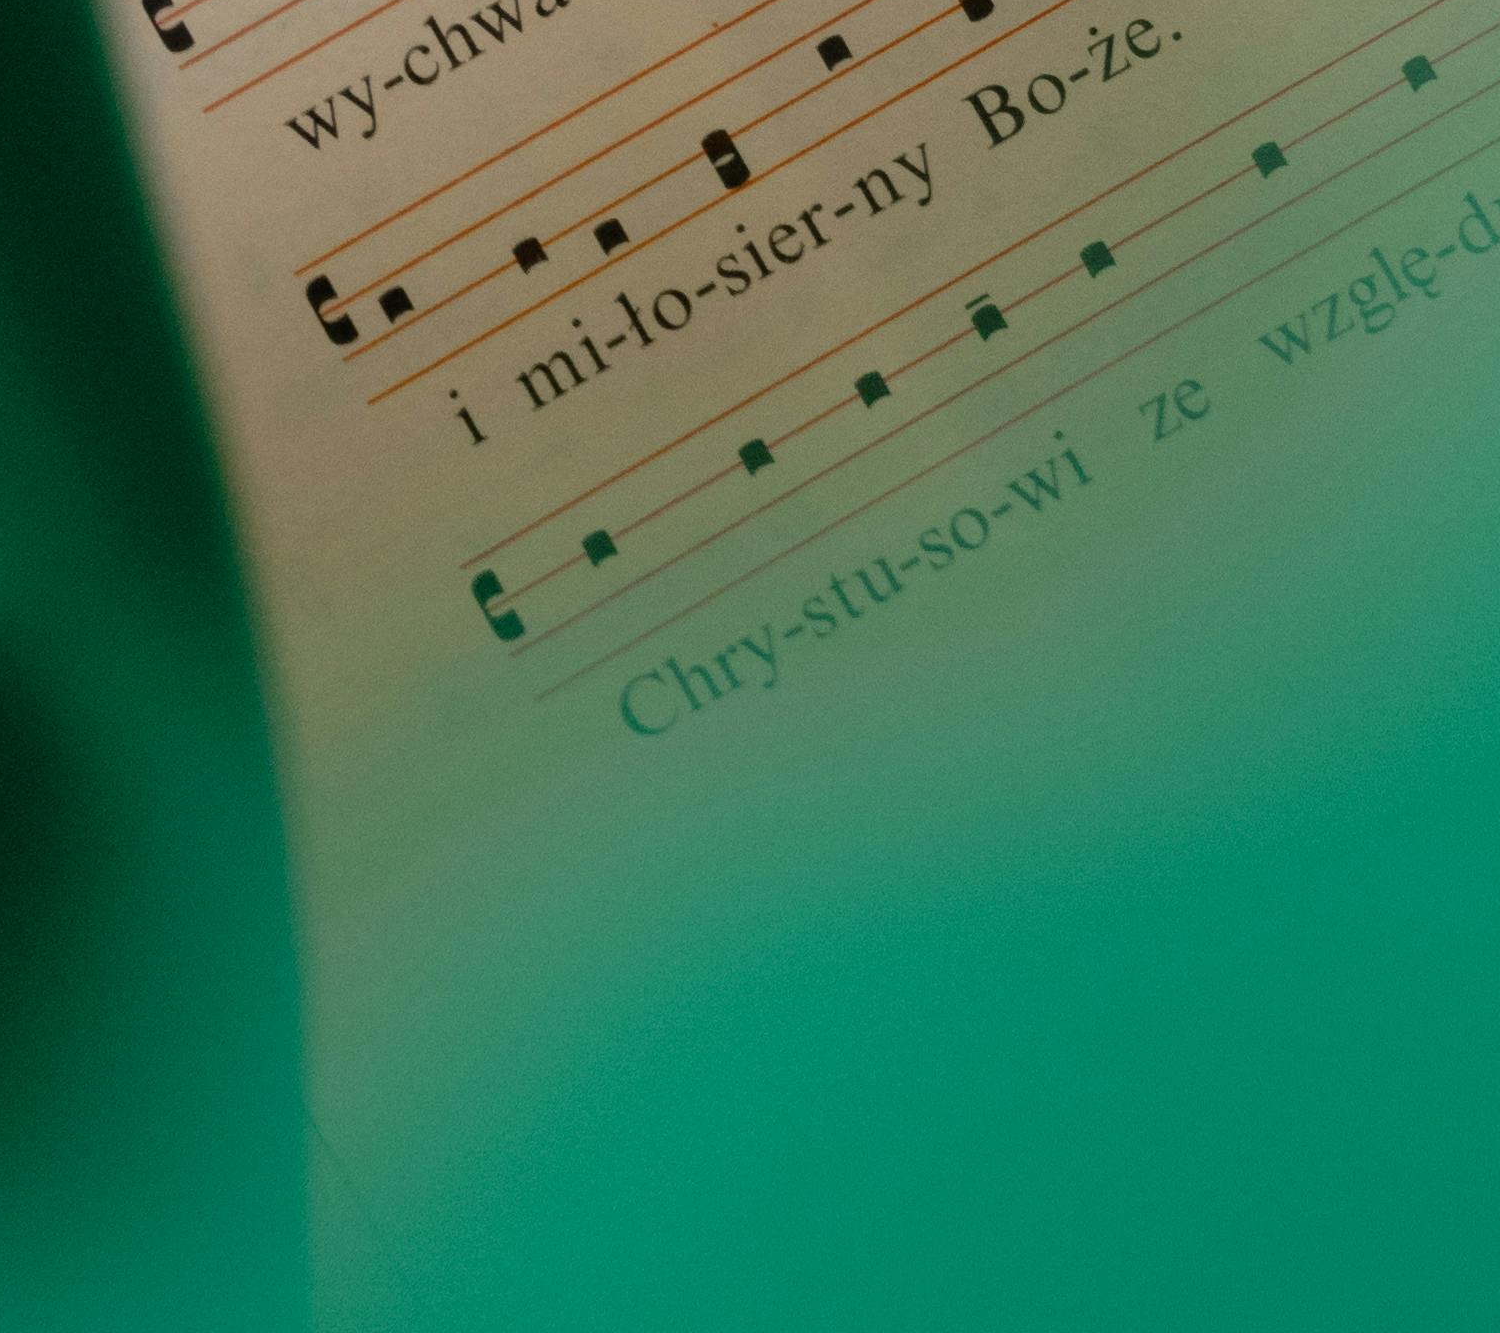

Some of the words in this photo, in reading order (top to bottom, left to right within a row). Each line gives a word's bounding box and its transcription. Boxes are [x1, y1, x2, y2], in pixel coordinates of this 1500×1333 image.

[448, 386, 488, 446] i
[515, 140, 936, 411] mi-ło-sier-ny
[960, 14, 1183, 148] Bo-że.
[618, 429, 1095, 737] Chry-stu-so-wi
[1138, 375, 1213, 443] ze
